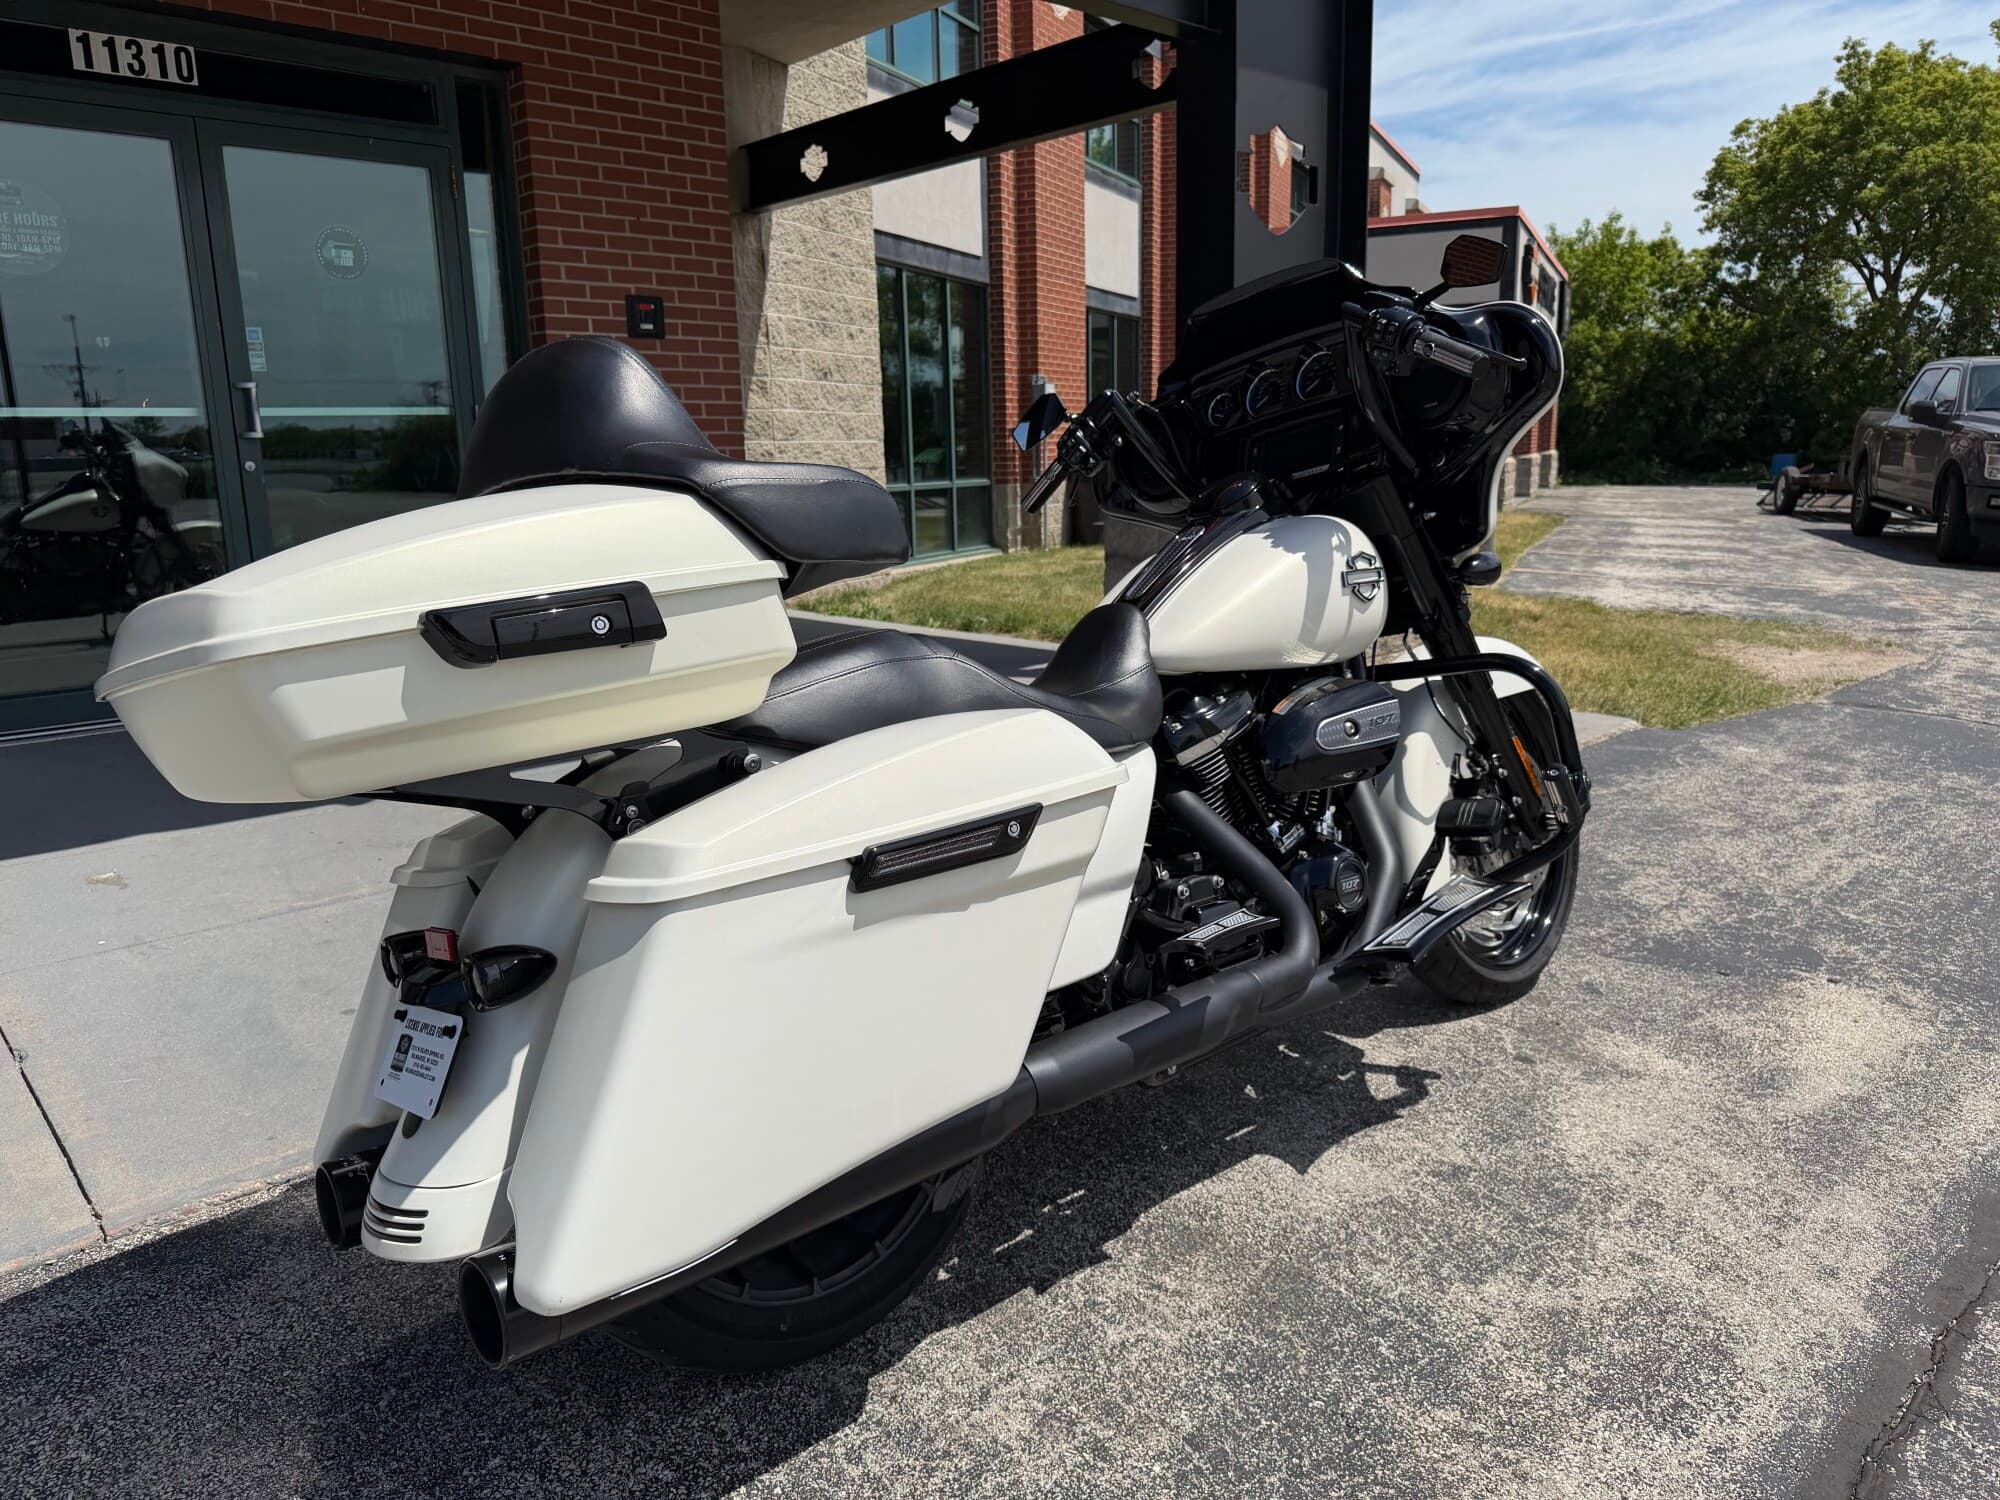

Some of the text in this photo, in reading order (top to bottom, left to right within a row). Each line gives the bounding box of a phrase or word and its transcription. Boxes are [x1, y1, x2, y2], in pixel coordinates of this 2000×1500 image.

[75, 32, 195, 83] 11310
[14, 212, 58, 227] HOURS
[1367, 713, 1396, 729] 107
[1342, 879, 1360, 891] 107
[405, 1018, 420, 1032] LICENSE
[419, 1022, 437, 1036] APPLIED
